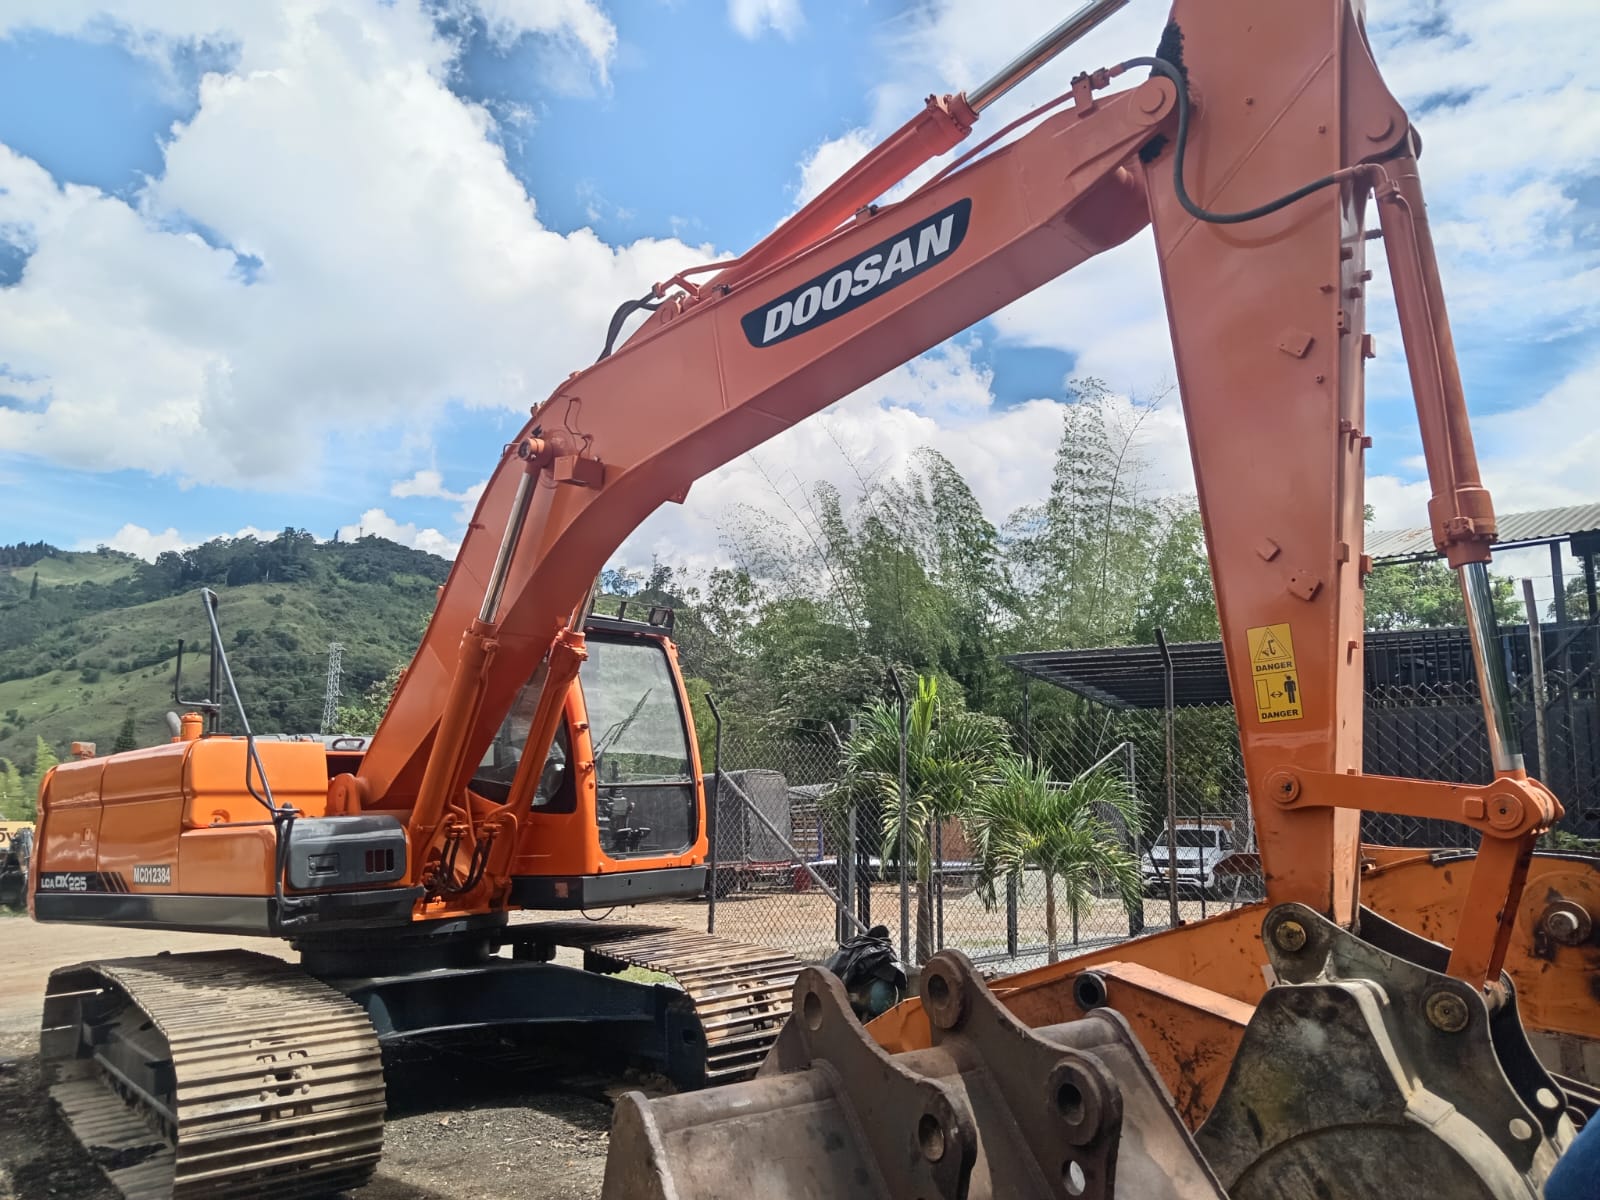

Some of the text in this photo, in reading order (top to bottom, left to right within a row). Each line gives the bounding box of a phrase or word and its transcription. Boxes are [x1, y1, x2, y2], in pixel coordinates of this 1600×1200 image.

[762, 213, 954, 344] DOOSAN
[1255, 661, 1292, 671] DANGER
[1261, 709, 1298, 719] DANGER
[133, 867, 171, 883] MC012384
